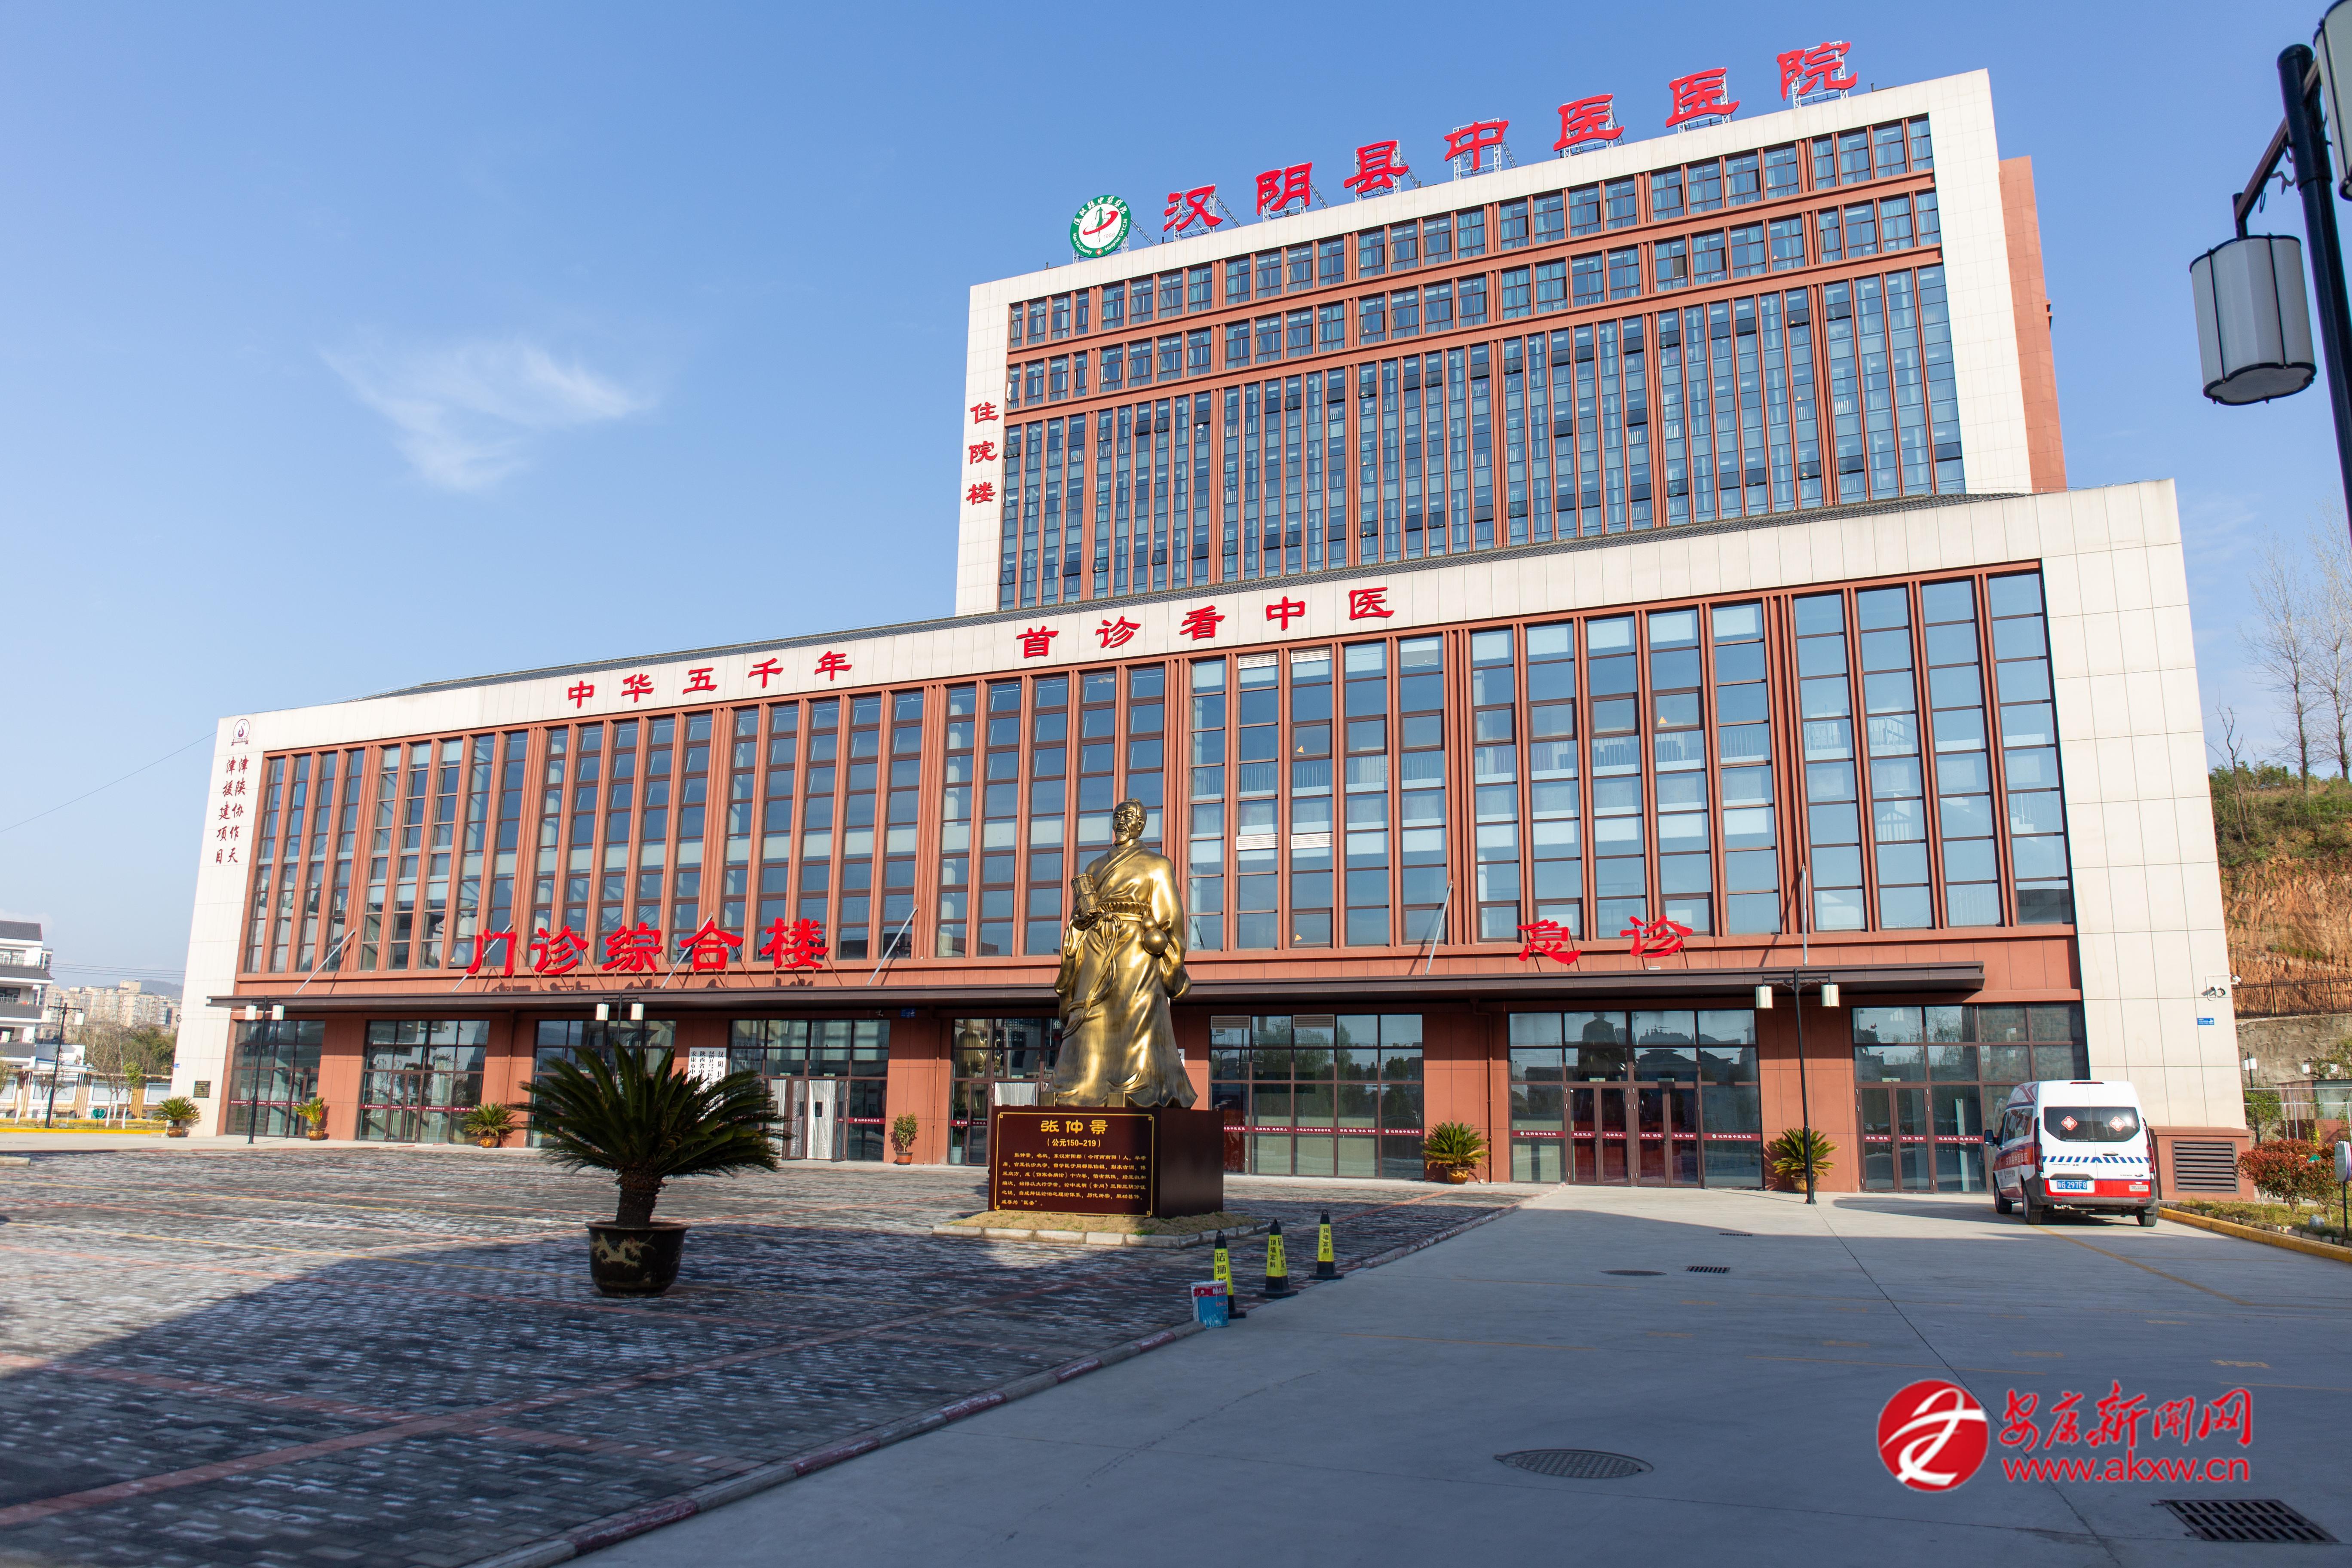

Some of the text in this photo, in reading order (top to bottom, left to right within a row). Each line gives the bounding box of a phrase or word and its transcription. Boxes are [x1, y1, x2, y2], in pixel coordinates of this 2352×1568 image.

[1164, 42, 1858, 233] 汉阴县中医医院
[966, 401, 999, 505] 住院楼
[568, 587, 1395, 708] 中华五千年 首诊看中医
[216, 756, 236, 864] 津援建项目
[227, 755, 249, 863] 津陕协作天
[466, 918, 830, 977] 门诊综合楼
[1516, 914, 1694, 965] 急诊
[1040, 1119, 1109, 1135] 张仲景
[1216, 1252, 1226, 1280] 法狮
